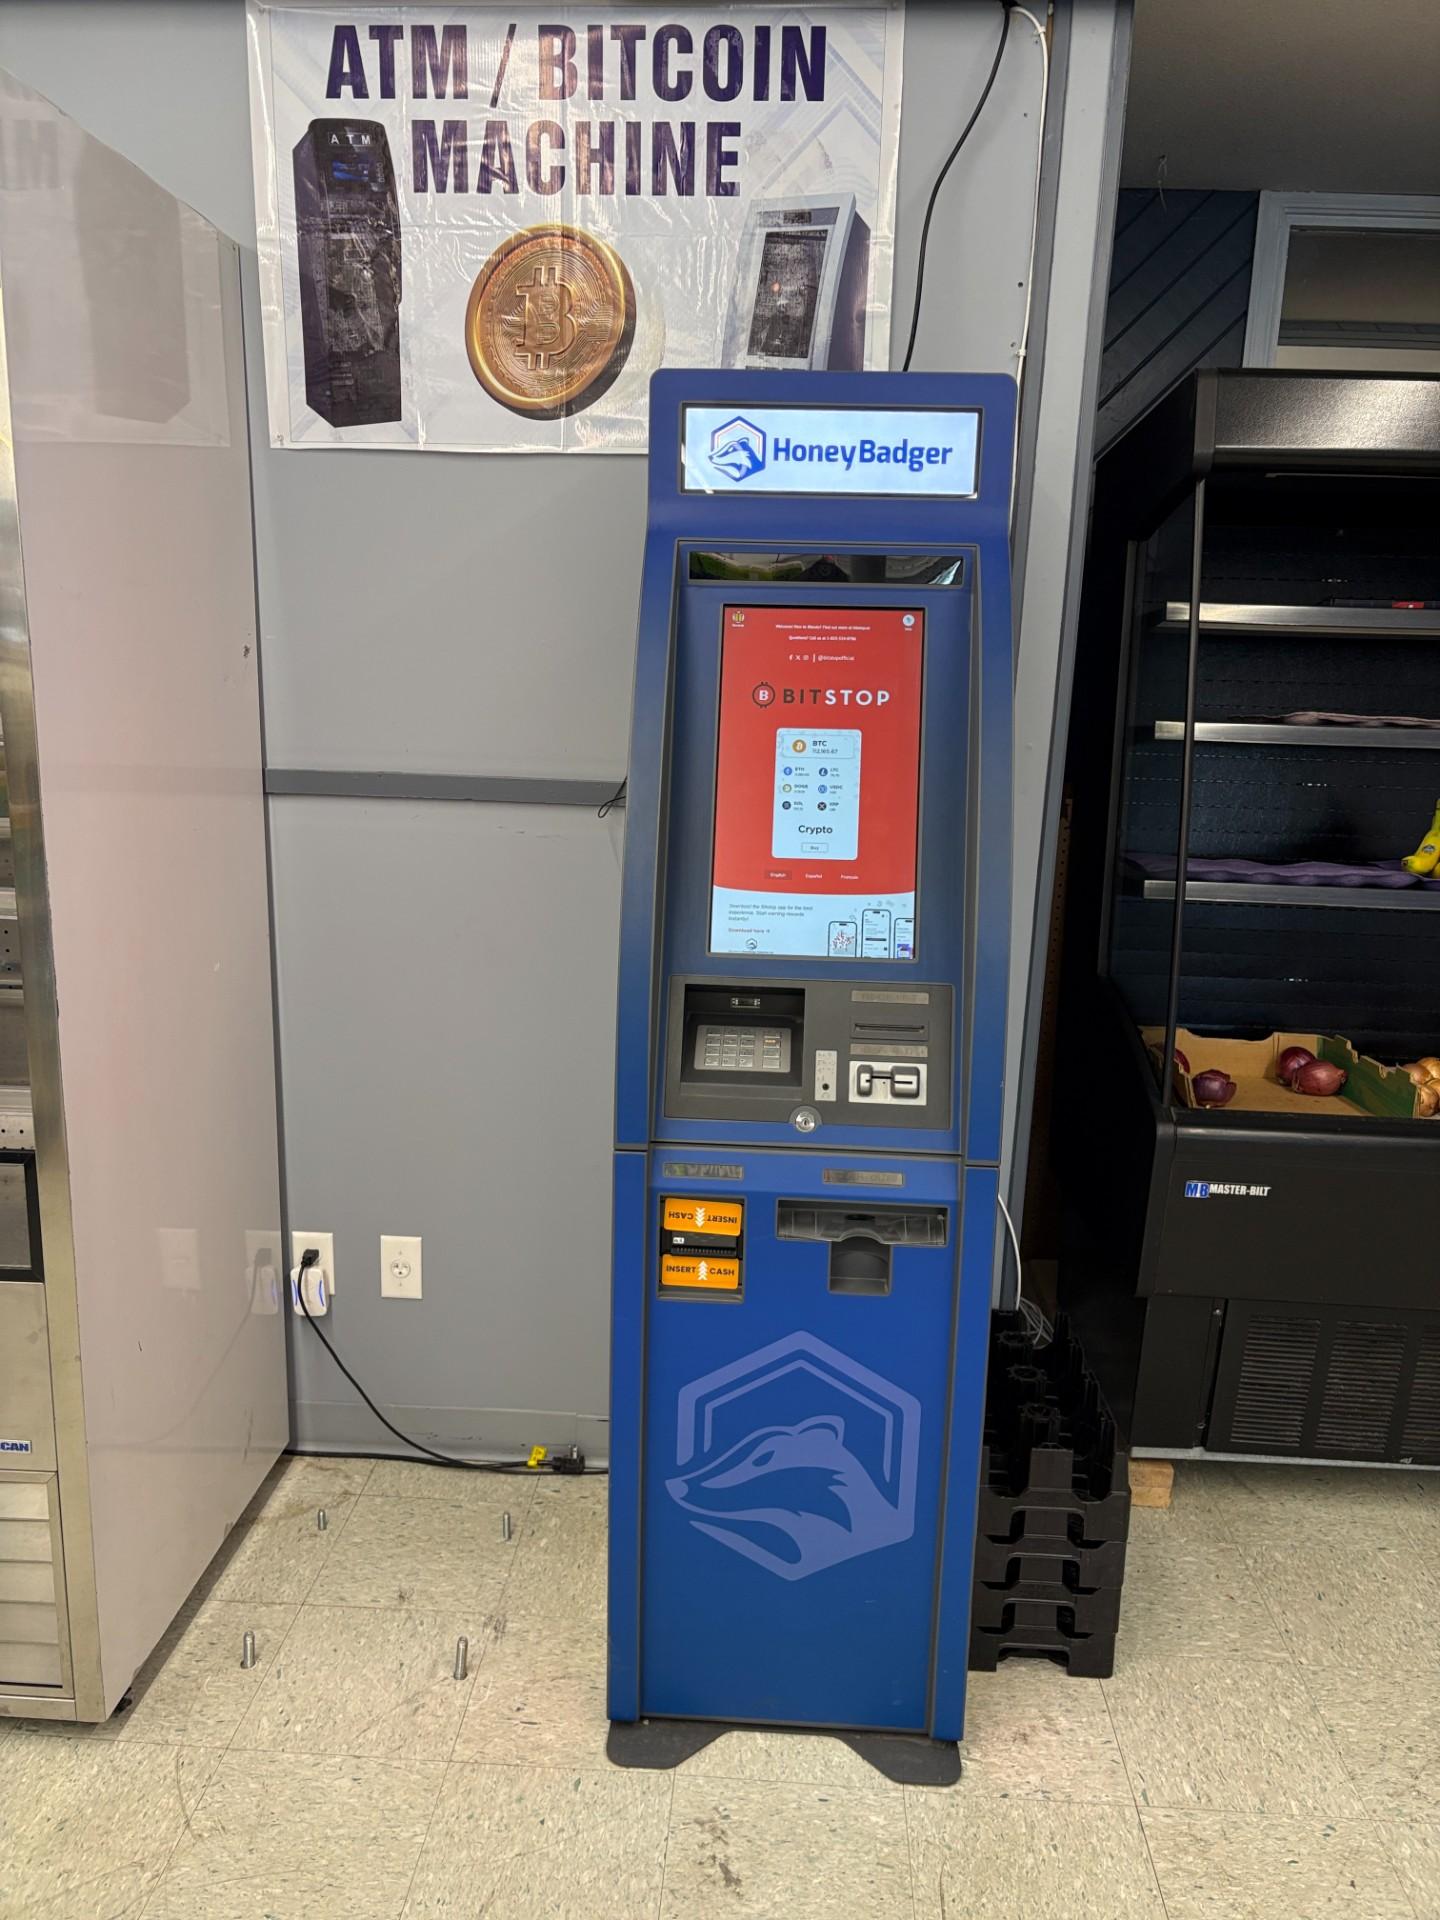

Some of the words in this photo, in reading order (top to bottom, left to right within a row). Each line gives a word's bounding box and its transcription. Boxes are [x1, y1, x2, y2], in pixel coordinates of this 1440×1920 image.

[325, 24, 468, 99] ATM
[538, 24, 827, 102] BITCOIN
[330, 133, 371, 145] ATM
[411, 119, 741, 197] MACHINE
[773, 437, 953, 472] HoneyBadger
[783, 688, 890, 706] BITSTOP
[798, 825, 833, 835] Crypto
[1209, 1183, 1271, 1197] MASTER-BILT
[668, 1211, 694, 1220] CASH
[707, 1215, 738, 1224] INSERT
[666, 1265, 696, 1273] INSERT
[709, 1267, 735, 1276] CASH
